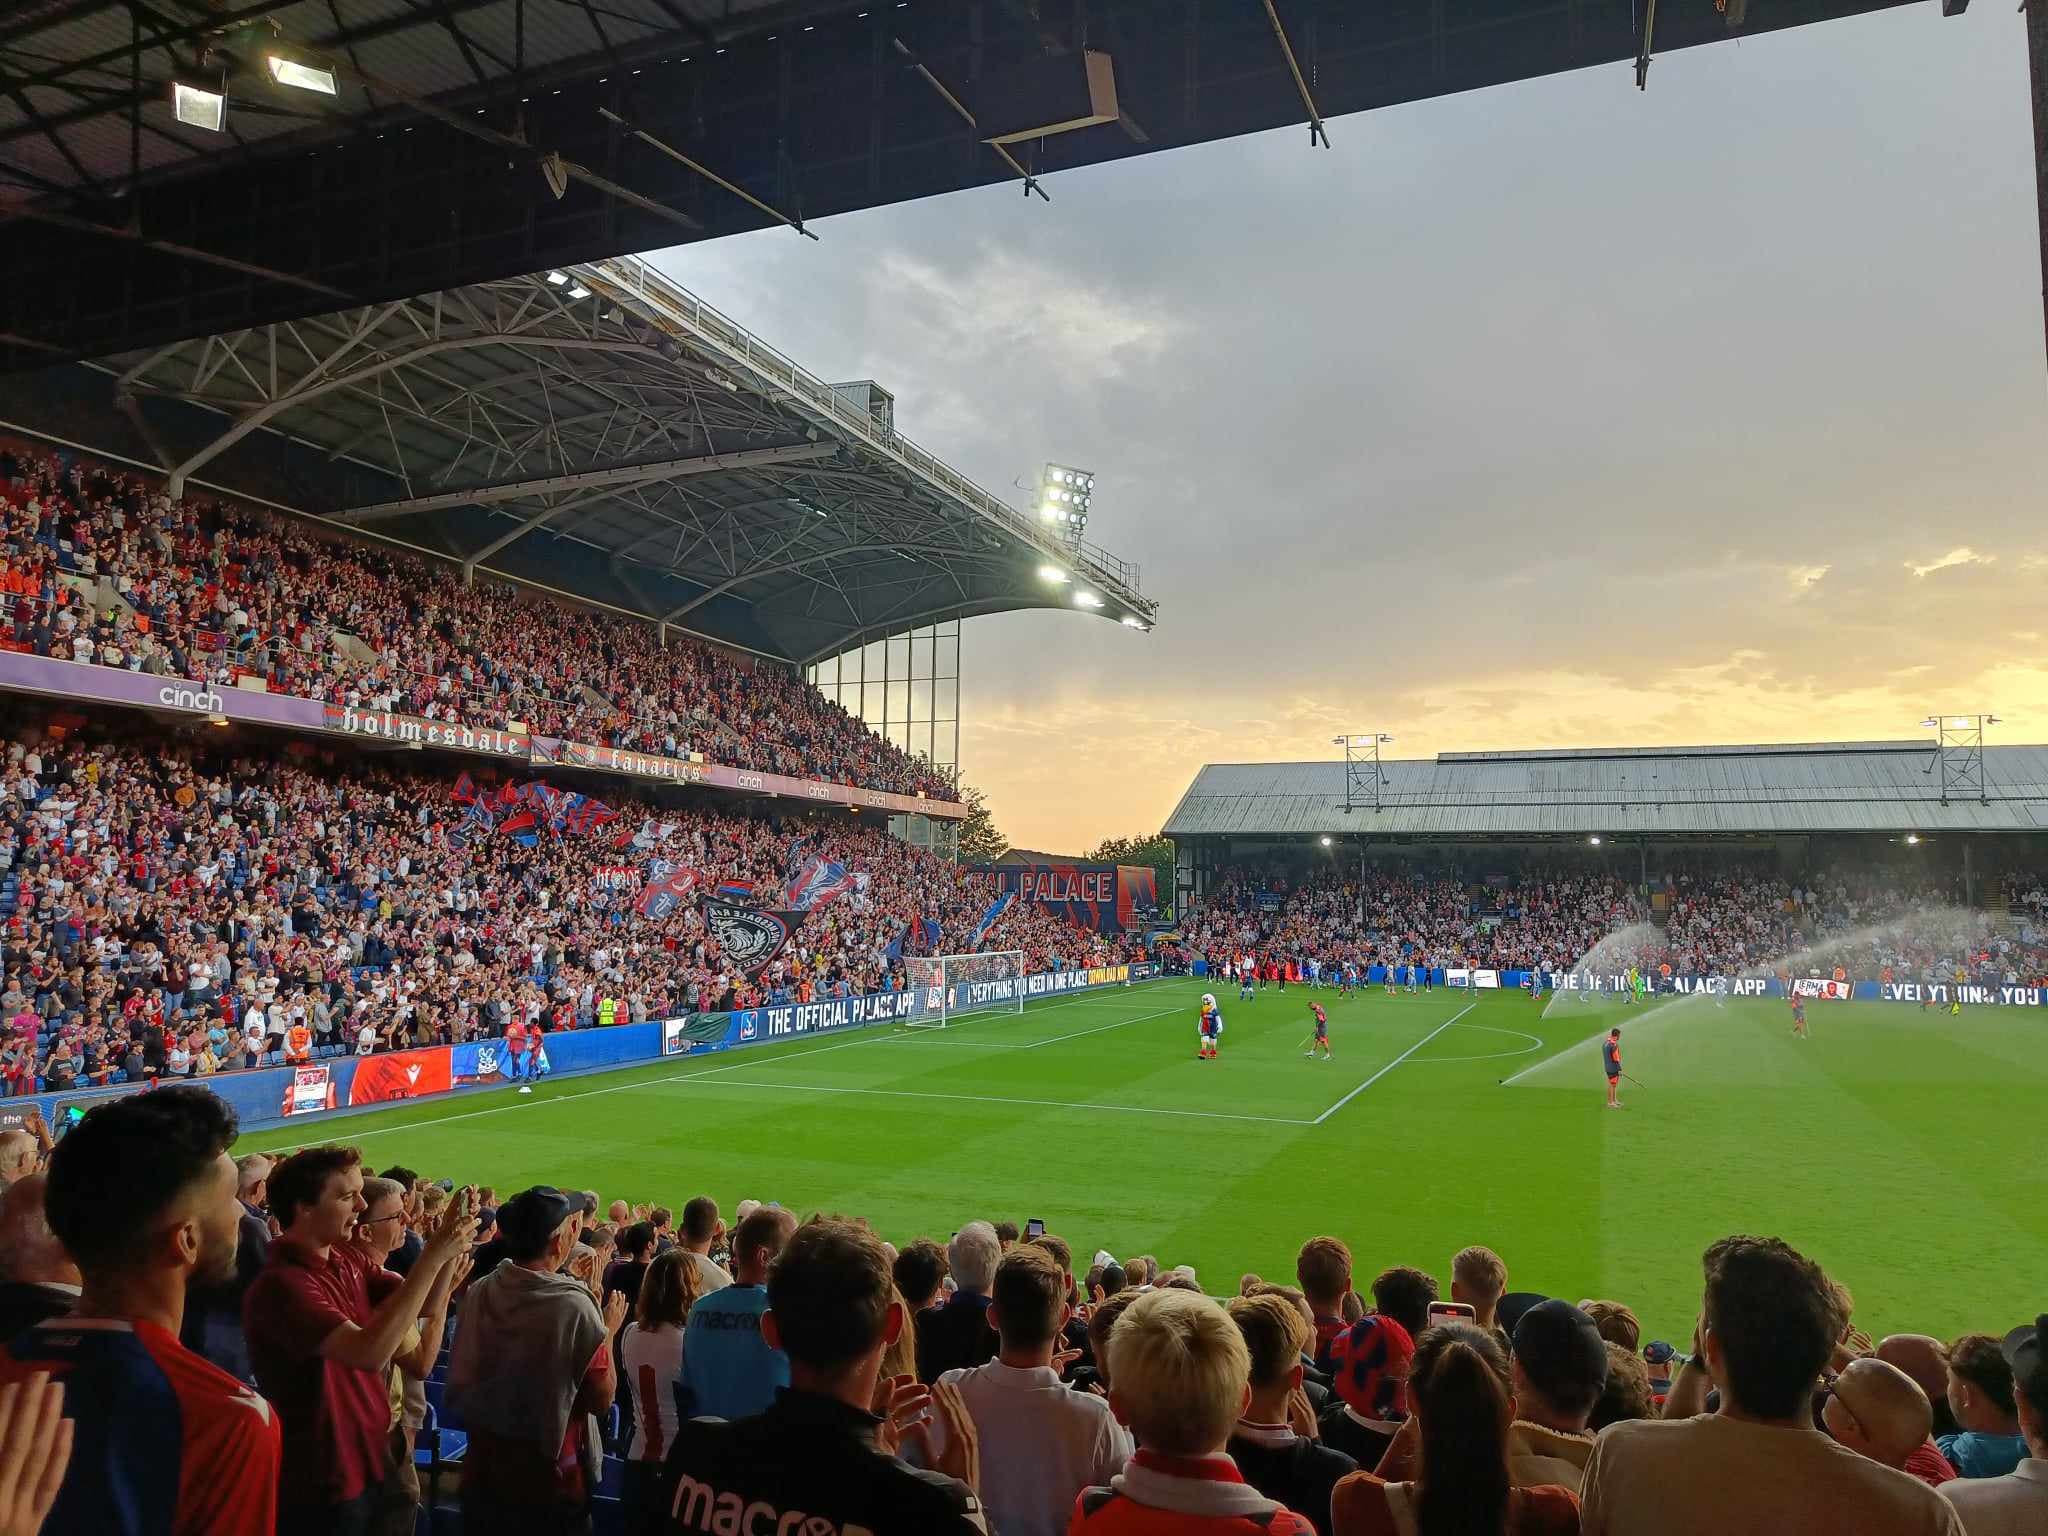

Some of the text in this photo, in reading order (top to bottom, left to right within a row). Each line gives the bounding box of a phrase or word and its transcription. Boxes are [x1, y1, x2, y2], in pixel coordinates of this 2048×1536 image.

[159, 681, 223, 713] cinch
[343, 706, 703, 782] holmesdale fanatics
[737, 774, 763, 790] cinch
[808, 785, 830, 800] cinch
[1020, 872, 1113, 902] PALACE
[1028, 975, 1046, 994] NEED
[1046, 974, 1054, 991] IN
[1055, 972, 1067, 990] ONE
[1733, 978, 1766, 996] APP
[2000, 987, 2039, 1005] YOU
[767, 1006, 793, 1036] THE
[796, 1001, 849, 1031] OFFICIAL
[852, 994, 894, 1022] PALACE
[895, 992, 915, 1016] APP
[3, 1115, 22, 1125] the
